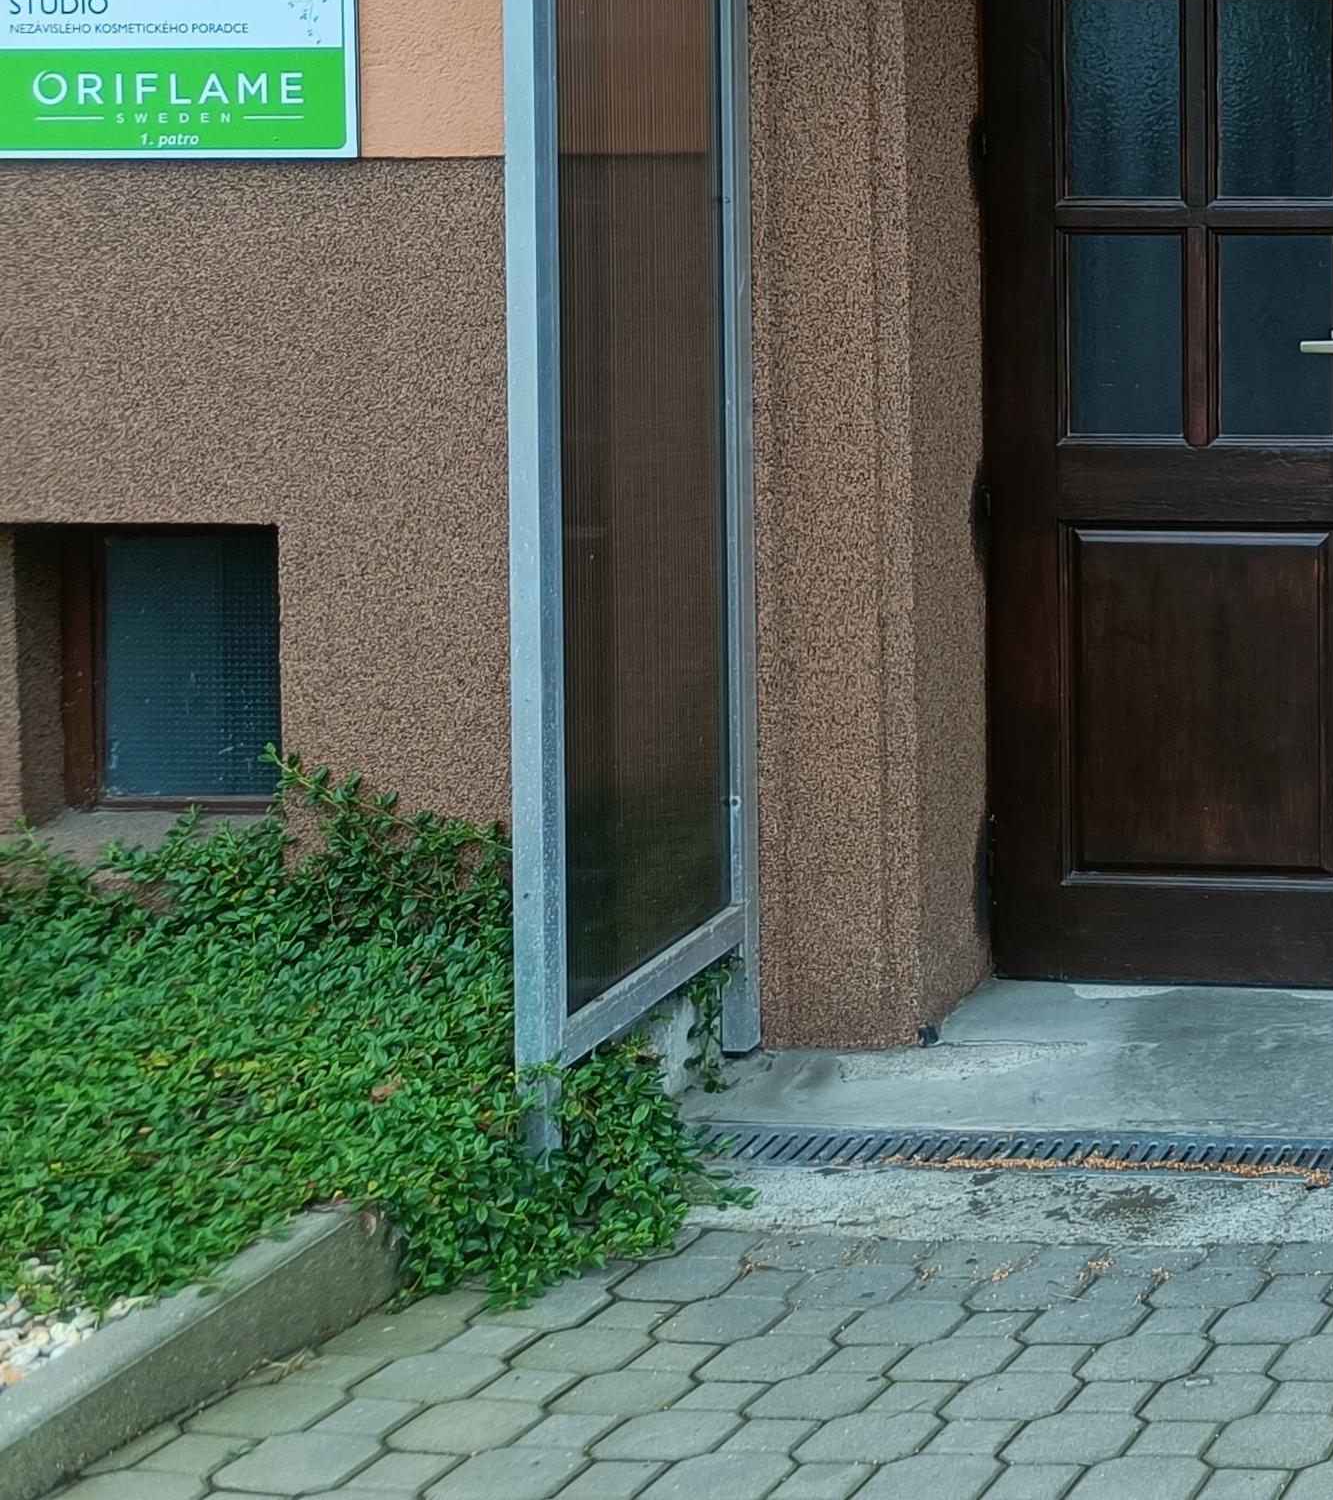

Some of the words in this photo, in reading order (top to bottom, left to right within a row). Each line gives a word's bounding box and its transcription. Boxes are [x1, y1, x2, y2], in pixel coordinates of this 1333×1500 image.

[10, 21, 91, 34] NEZÁVISLÉHO
[95, 21, 189, 34] KOSMETICKÉHO
[192, 23, 249, 34] PORADCE
[33, 70, 304, 105] ORIFLAME
[116, 113, 232, 123] SWEDEN
[140, 133, 153, 145] 1.
[158, 133, 199, 147] patro
